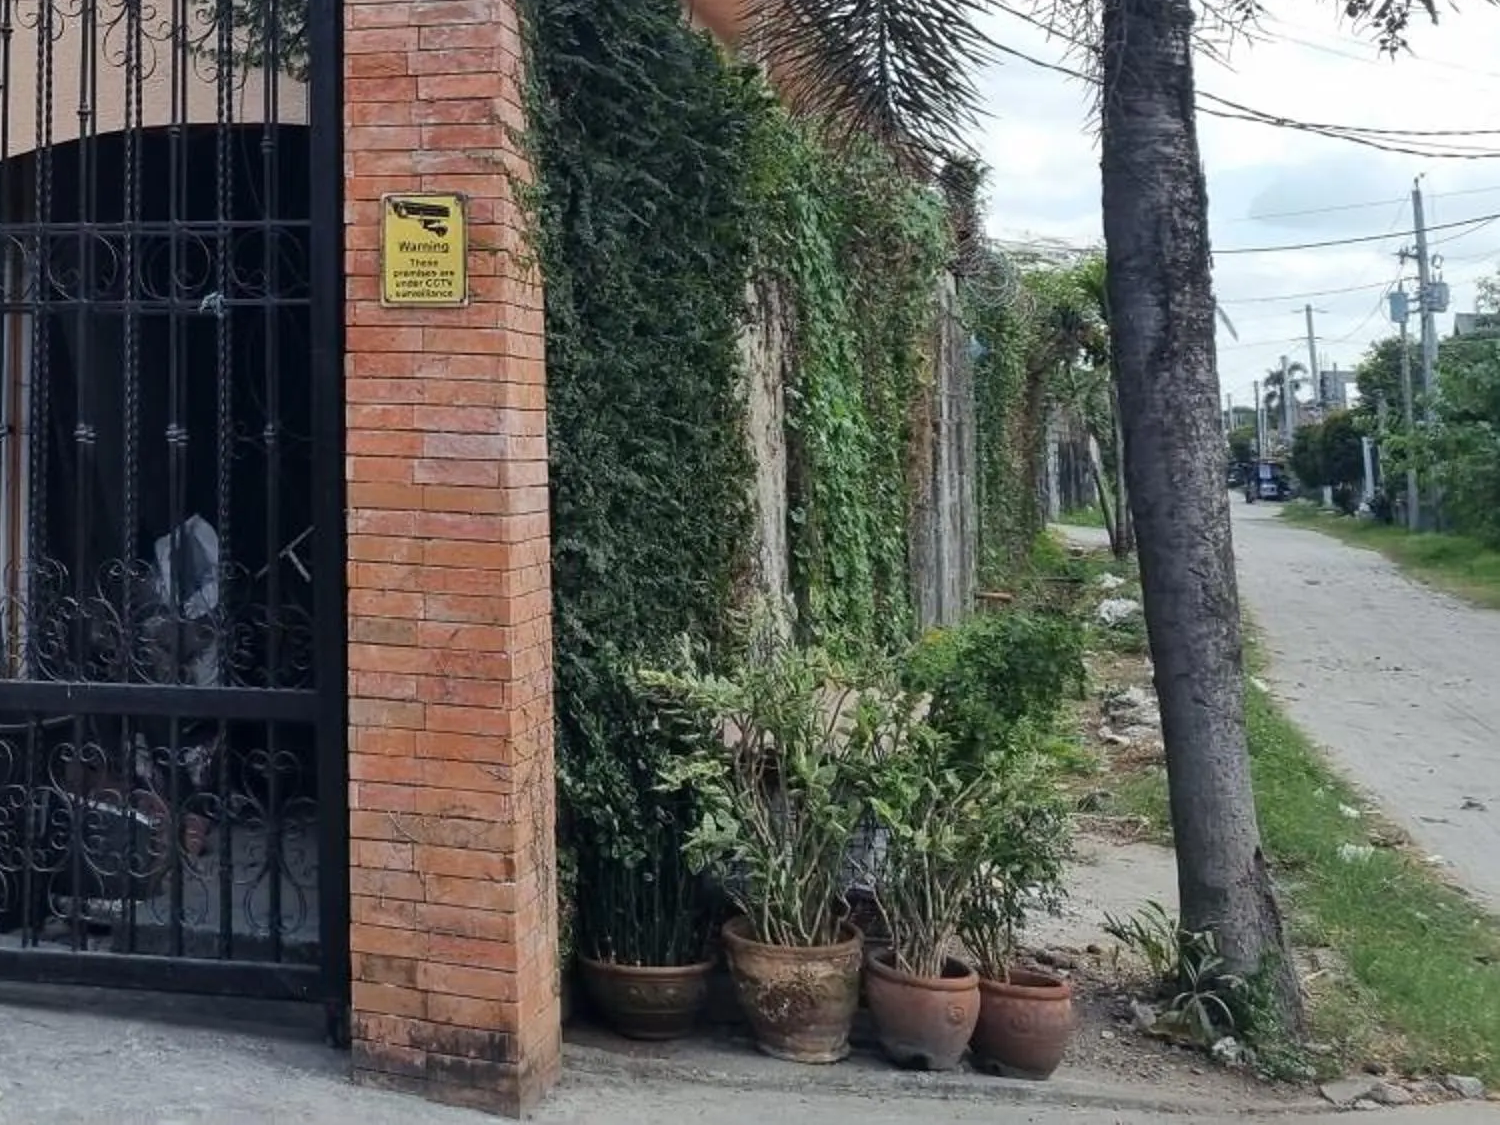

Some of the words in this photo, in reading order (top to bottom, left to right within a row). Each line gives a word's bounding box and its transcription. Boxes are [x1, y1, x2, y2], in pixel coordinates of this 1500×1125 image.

[399, 241, 449, 253] Warning
[410, 258, 439, 267] These
[395, 279, 423, 287] under
[395, 288, 453, 297] surveillance
